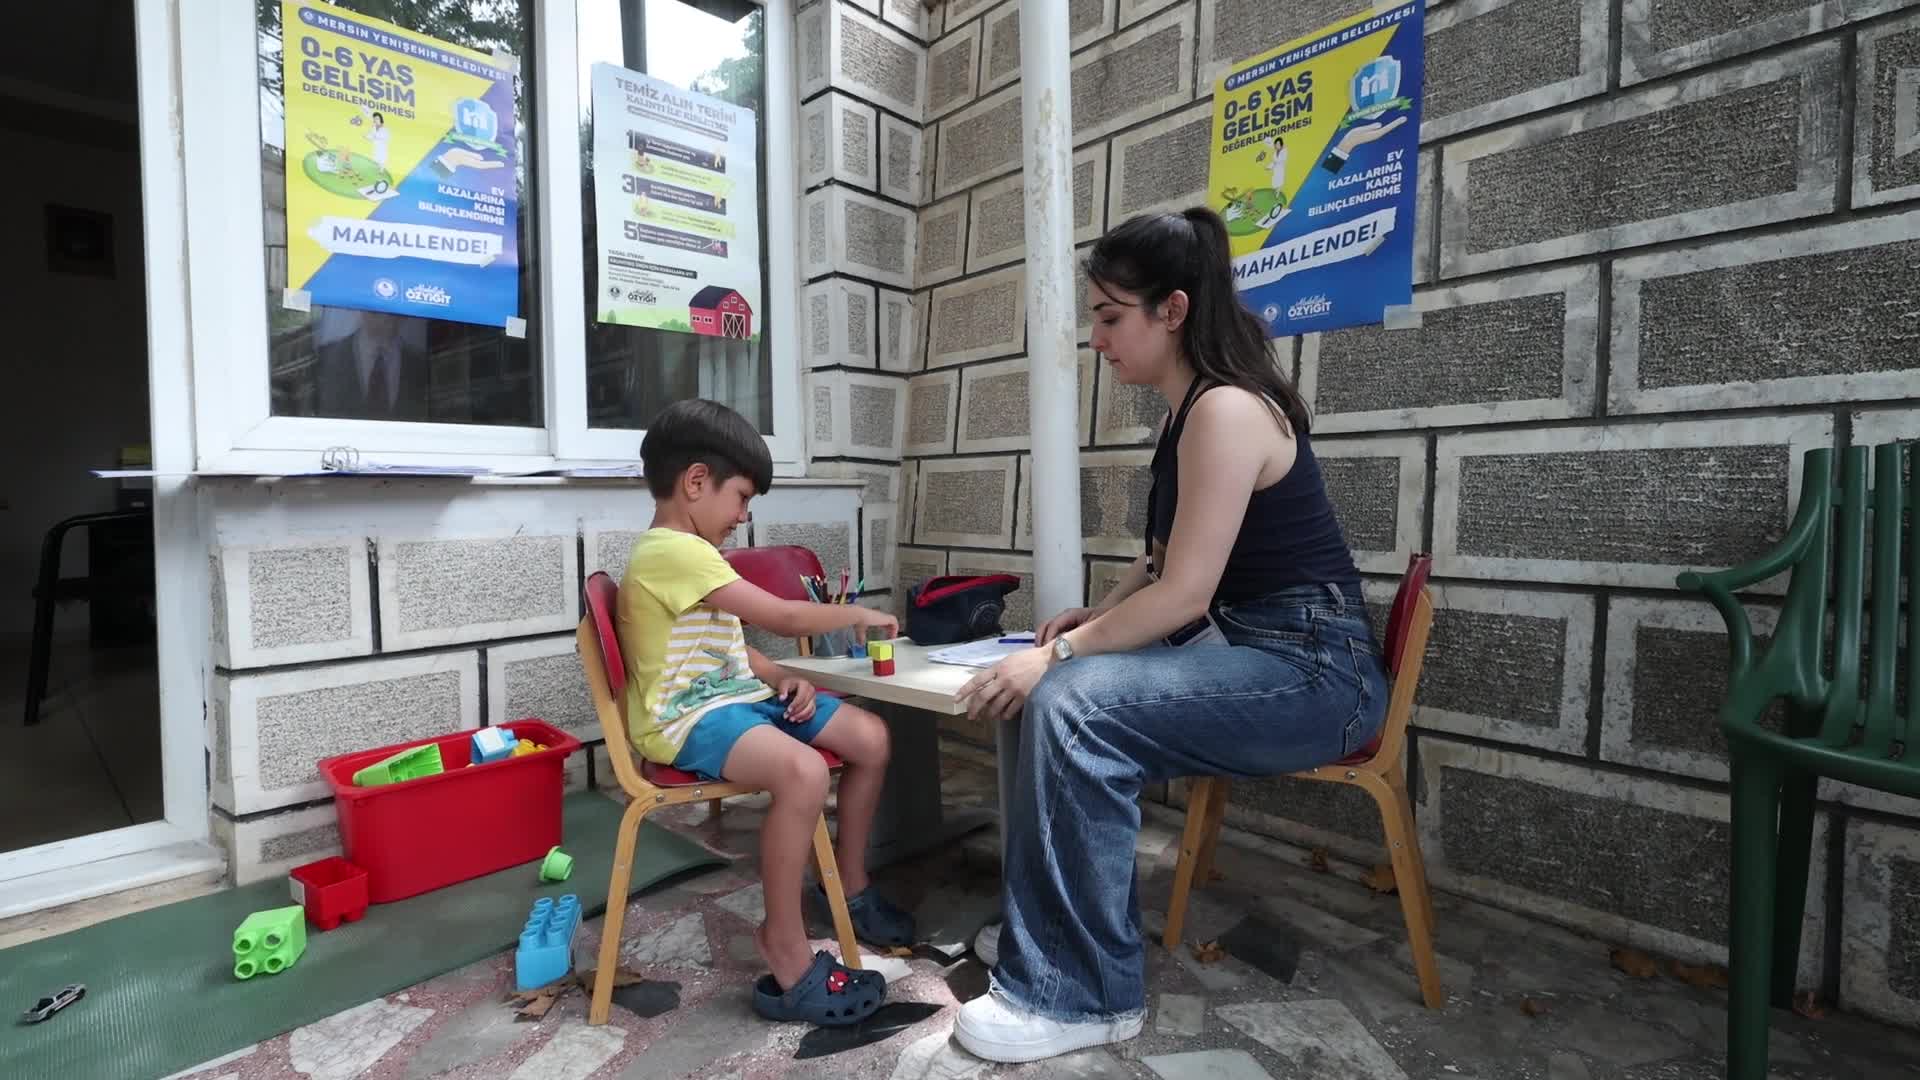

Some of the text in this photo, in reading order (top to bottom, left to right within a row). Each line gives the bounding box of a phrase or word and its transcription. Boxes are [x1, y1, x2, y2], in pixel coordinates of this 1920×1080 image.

[301, 36, 414, 86] 0-6 YAŞ
[1237, 5, 1415, 84] MERSİN YENİŞEHİR BELEDİYESİ
[302, 60, 415, 107] GELİŞİM
[1224, 71, 1312, 120] 0-6 YAŞ
[303, 82, 415, 120] DEĞERLENDİRMESİ
[1223, 92, 1313, 141] GELİŞİM
[1222, 117, 1312, 154] DEĞERLENDİRMESİ
[1387, 149, 1404, 162] EV
[491, 186, 505, 196] EV
[622, 173, 635, 194] 3
[1328, 161, 1403, 191] KAZALARINA
[438, 184, 505, 206] KAZALARINA
[1308, 184, 1401, 217] BİLİNÇLENDİRME
[418, 200, 505, 226] BİLİNÇLENDİRME
[333, 226, 488, 254] MAHALLENDE!
[624, 220, 638, 240] 5
[1233, 220, 1377, 281] MAHALLENDE!
